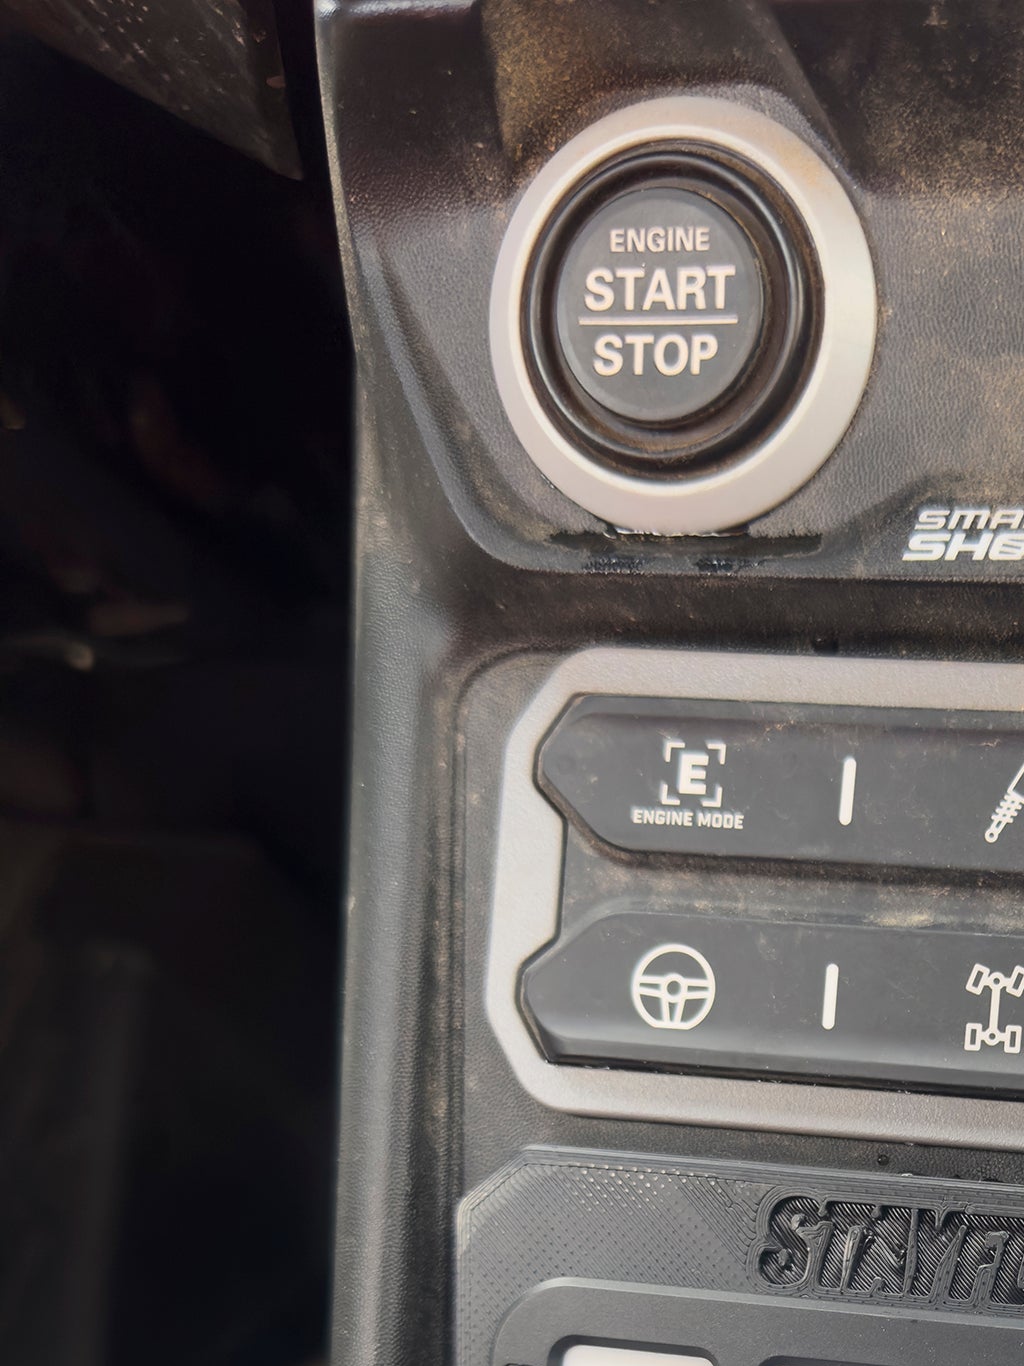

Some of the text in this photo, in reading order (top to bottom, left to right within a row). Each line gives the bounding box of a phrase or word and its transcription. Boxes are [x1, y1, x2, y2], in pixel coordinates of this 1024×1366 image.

[609, 226, 711, 253] ENGINE
[584, 265, 737, 312] START
[592, 333, 719, 377] STOP
[676, 753, 710, 795] E
[631, 808, 745, 830] ENGINE MODE
